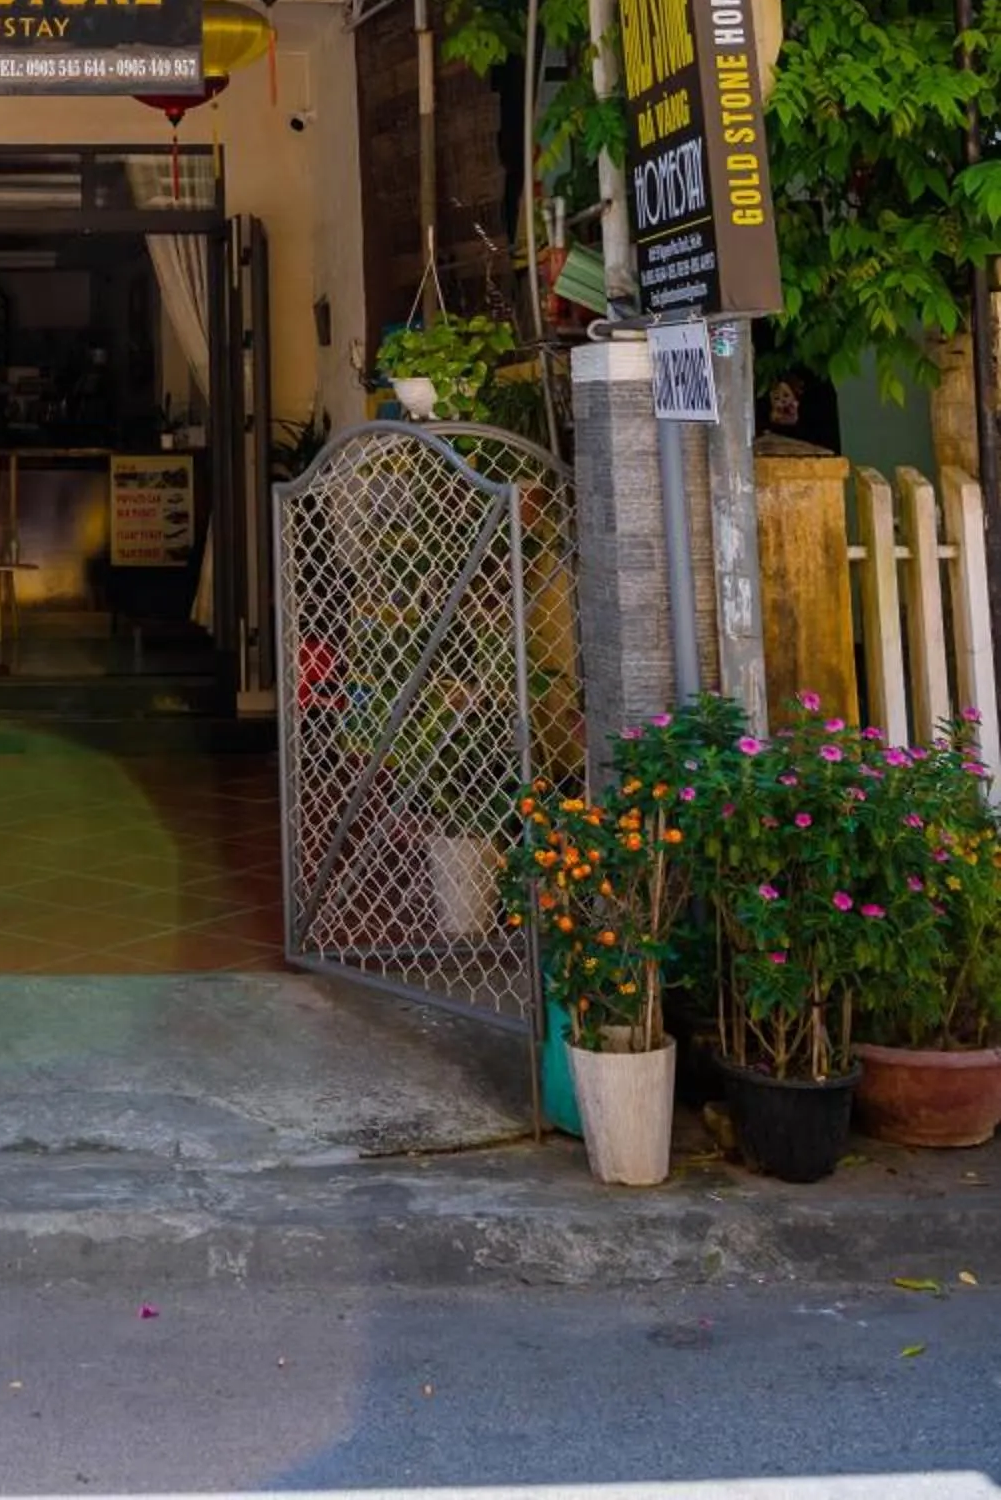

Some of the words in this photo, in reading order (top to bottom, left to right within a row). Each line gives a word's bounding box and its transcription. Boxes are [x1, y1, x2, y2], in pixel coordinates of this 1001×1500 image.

[716, 53, 756, 144] STONE
[634, 136, 706, 229] HOMESTAY
[727, 153, 764, 225] GOLD
